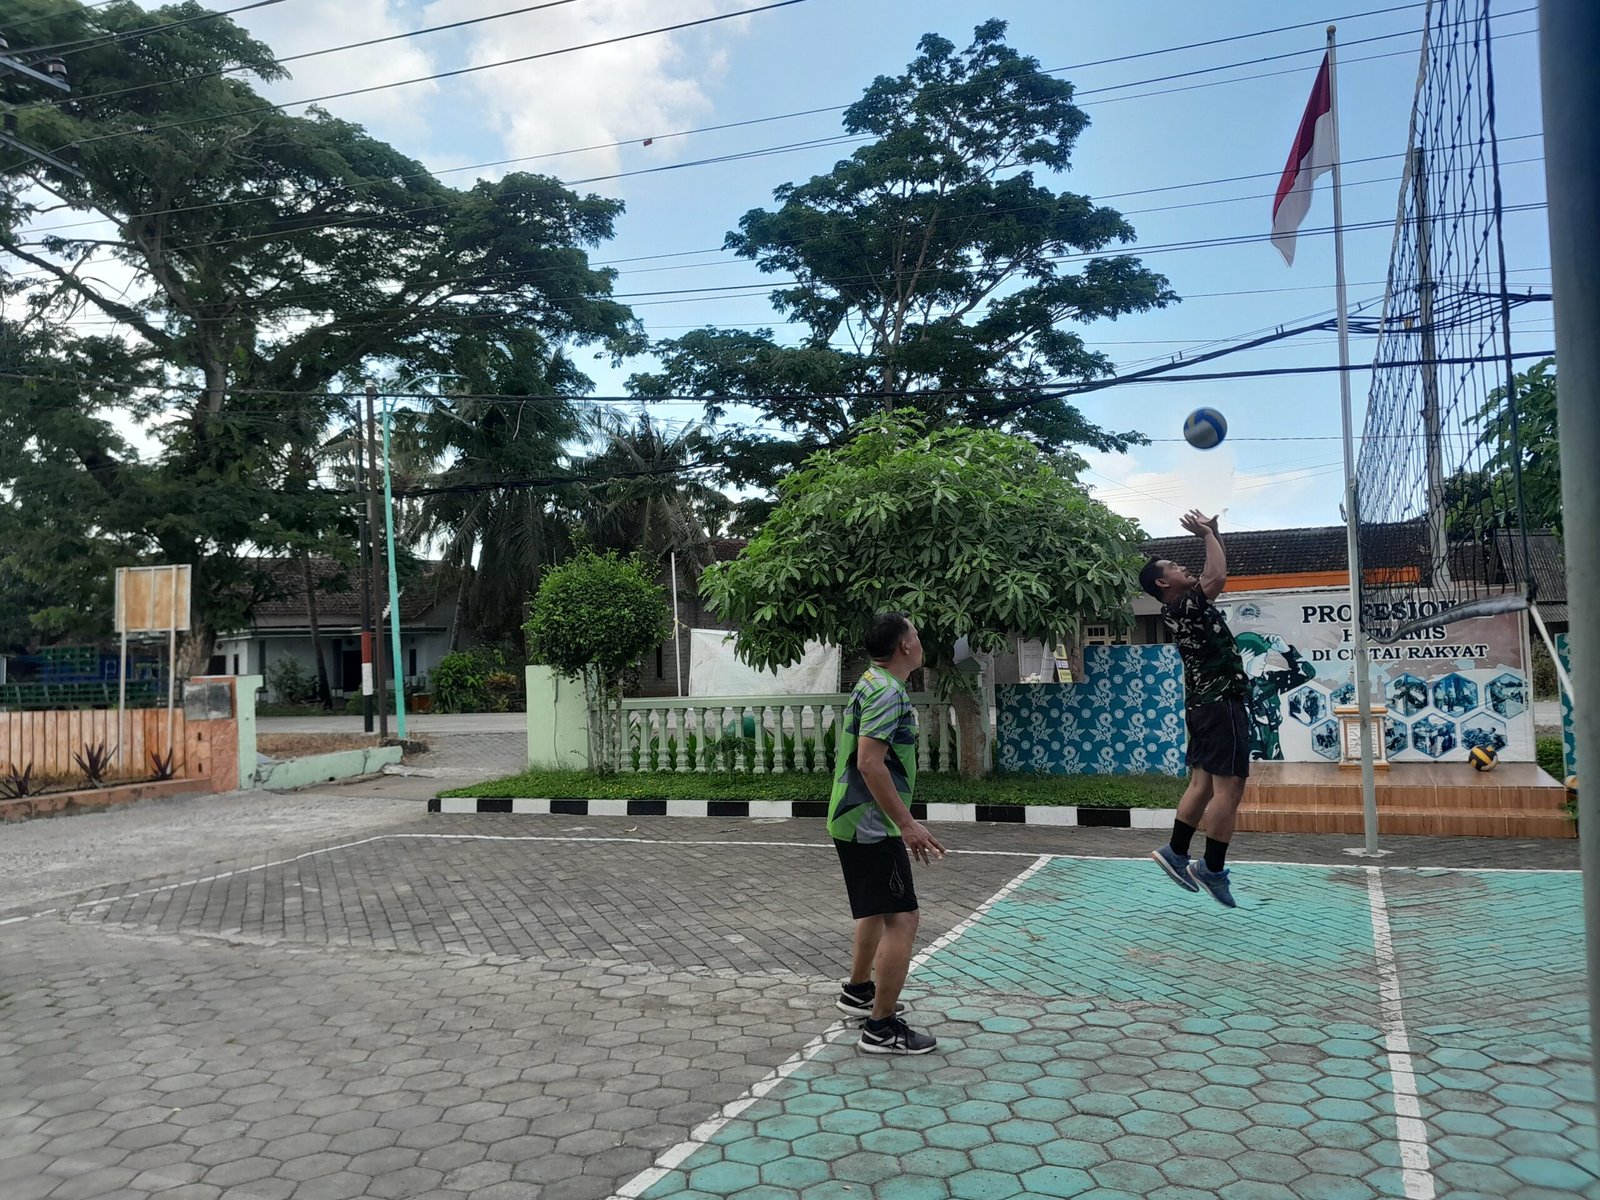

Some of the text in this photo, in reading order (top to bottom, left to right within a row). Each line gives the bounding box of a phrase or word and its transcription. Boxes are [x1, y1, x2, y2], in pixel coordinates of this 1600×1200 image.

[1312, 645, 1488, 661] DI CITAI RAKYAT
